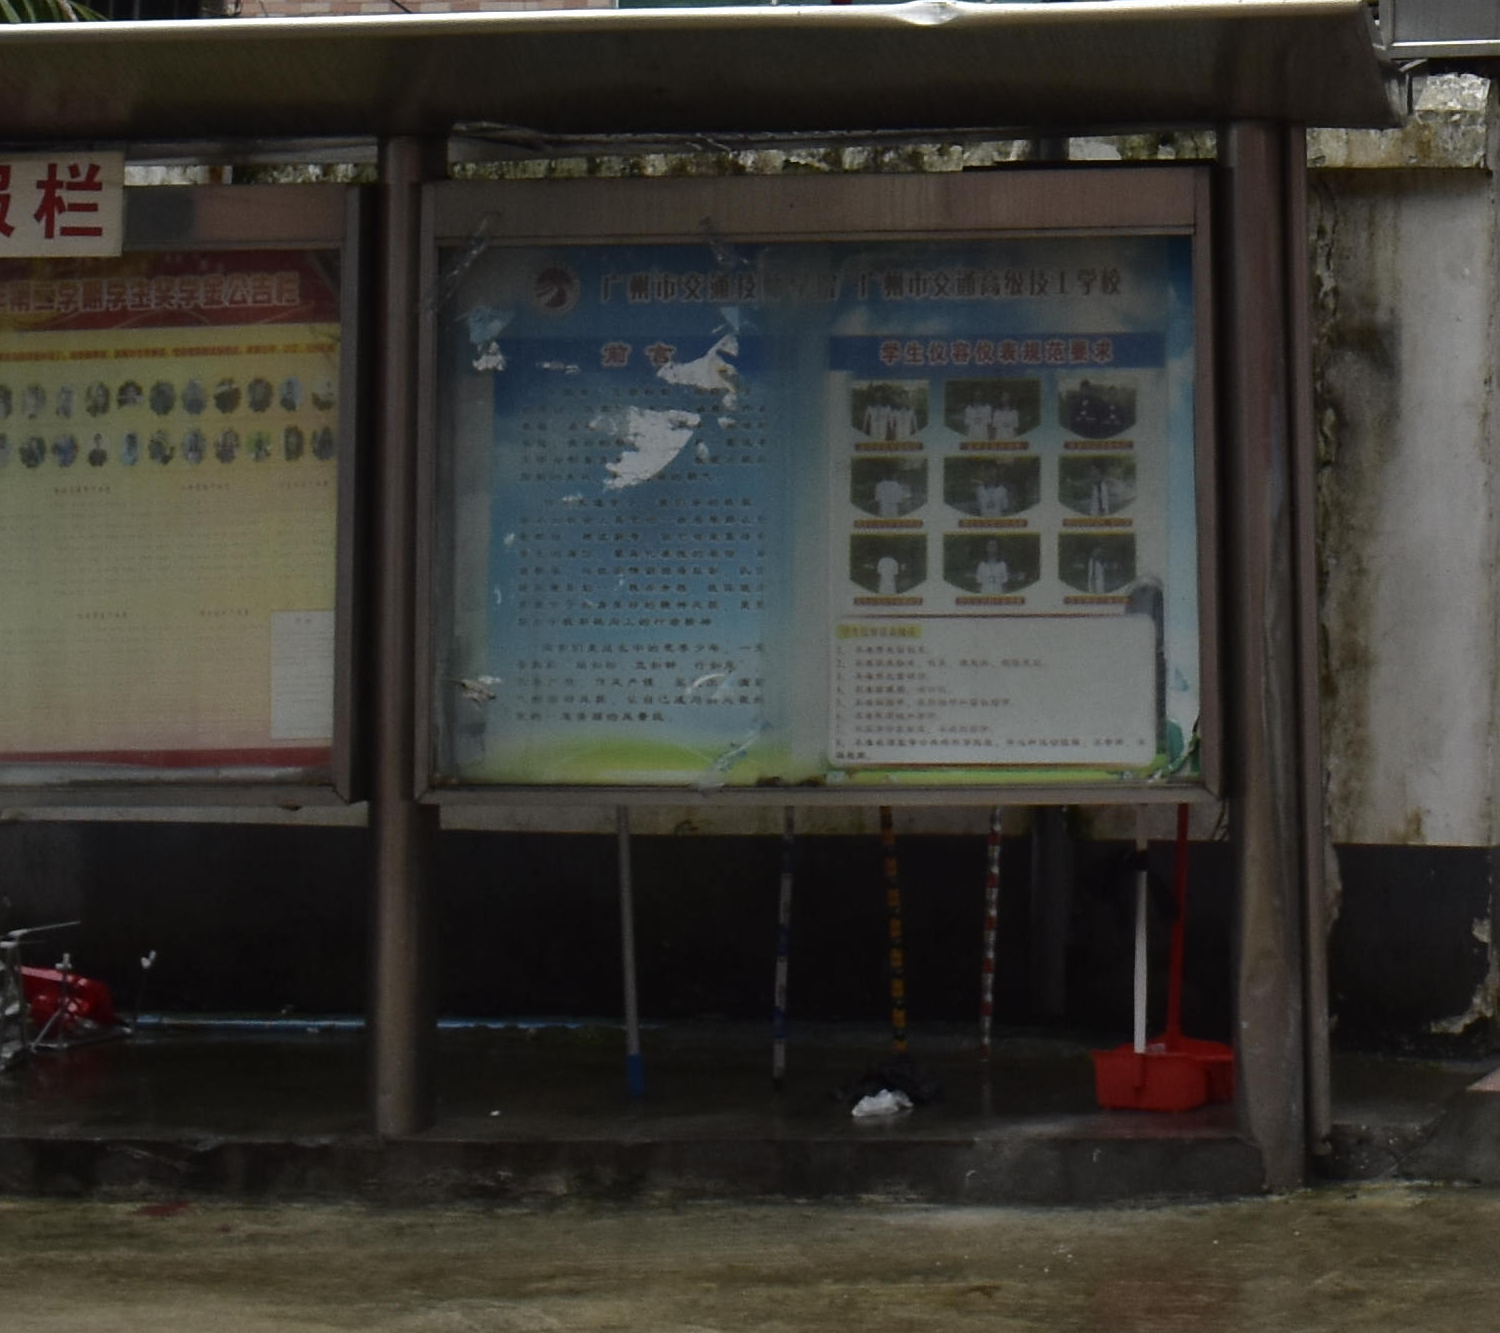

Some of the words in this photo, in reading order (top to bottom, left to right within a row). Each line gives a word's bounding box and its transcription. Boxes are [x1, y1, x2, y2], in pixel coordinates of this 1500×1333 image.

[602, 272, 838, 302] 广州市交通技院
[857, 266, 1122, 298] 广州市交通高级技工学校
[602, 342, 676, 366] 前言
[880, 340, 1114, 365] 学生仪容仪表规范要求
